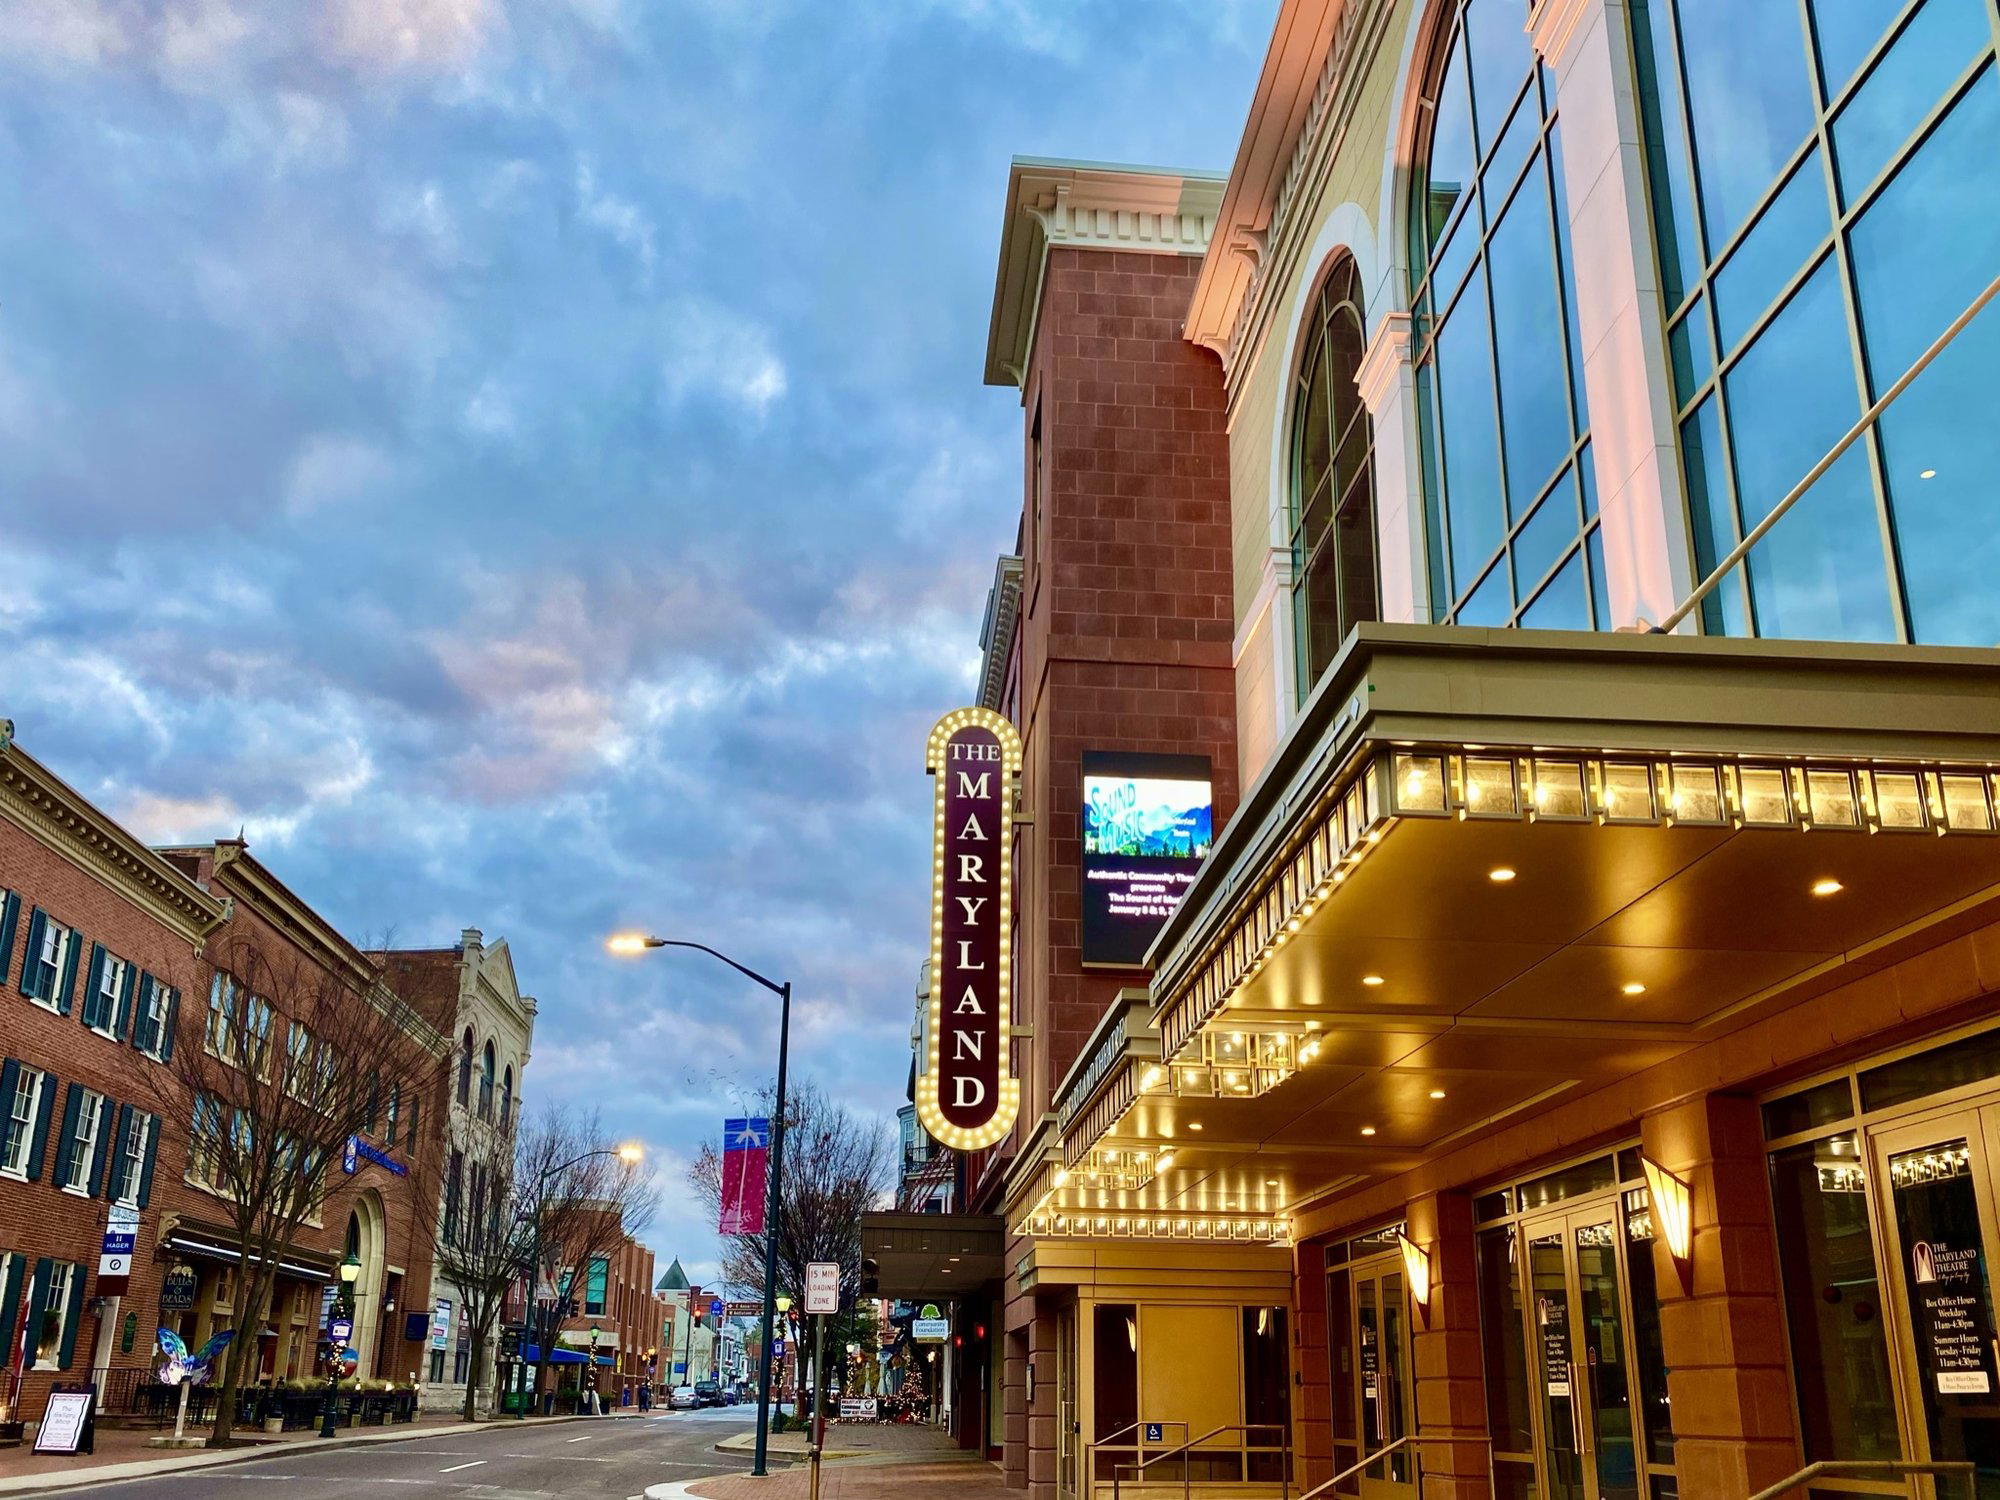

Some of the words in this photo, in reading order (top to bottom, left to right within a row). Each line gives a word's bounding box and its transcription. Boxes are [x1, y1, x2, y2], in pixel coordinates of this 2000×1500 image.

[948, 743, 1001, 762] THE
[1088, 869, 1127, 880] Authentic
[1128, 871, 1175, 884] Community
[1130, 884, 1166, 893] presents
[1109, 893, 1125, 902] The
[1126, 894, 1152, 903] Sound
[1152, 895, 1163, 903] of
[1109, 904, 1141, 916] January
[952, 771, 992, 1107] MARYLAND
[1932, 1242, 1948, 1253] THE
[1934, 1249, 1977, 1263] MARYLAND
[1935, 1260, 1969, 1273] THEATRE
[811, 1270, 819, 1278] 15
[822, 1270, 836, 1278] MIN
[167, 1277, 192, 1286] BULLS
[162, 1295, 192, 1303] BEARS
[1926, 1298, 1938, 1308] Box
[1937, 1296, 1956, 1306] Office
[1956, 1296, 1977, 1305] Hours
[1938, 1308, 1967, 1318] Weekdays
[1934, 1335, 1959, 1344] Summer
[1959, 1334, 1979, 1343] Hours
[1934, 1346, 1959, 1357] Tuesday
[1962, 1345, 1981, 1356] Friday
